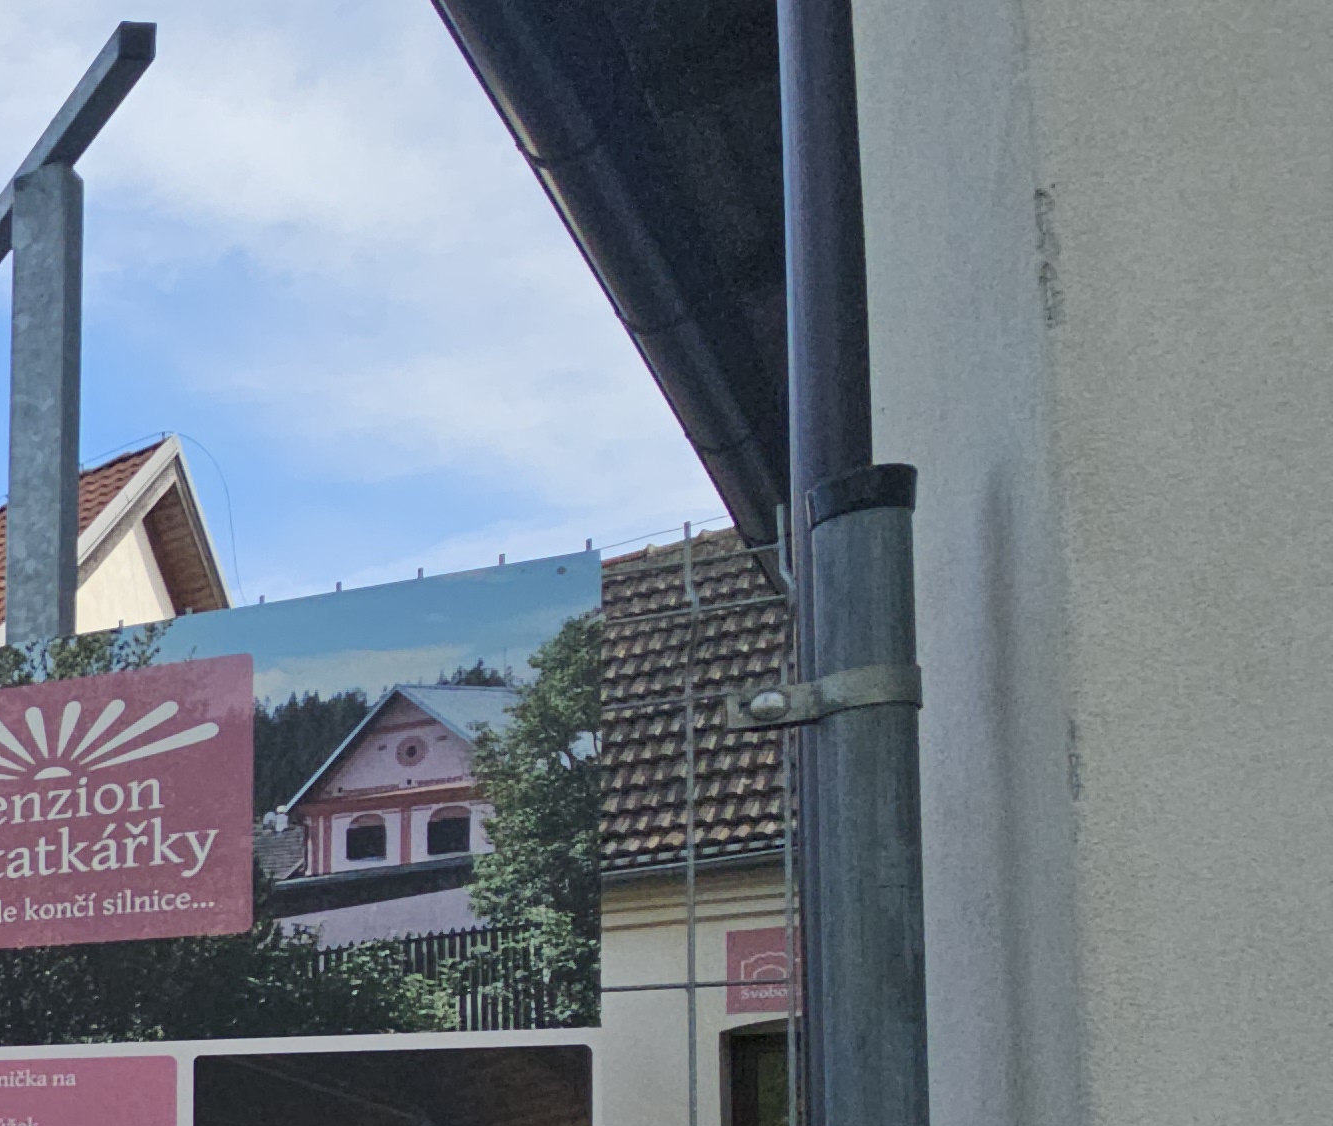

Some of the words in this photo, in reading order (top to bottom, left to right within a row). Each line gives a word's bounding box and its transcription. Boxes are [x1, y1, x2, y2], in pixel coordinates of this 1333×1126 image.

[24, 894, 96, 921] končí
[103, 890, 215, 916] silnice...
[52, 1073, 76, 1086] na
